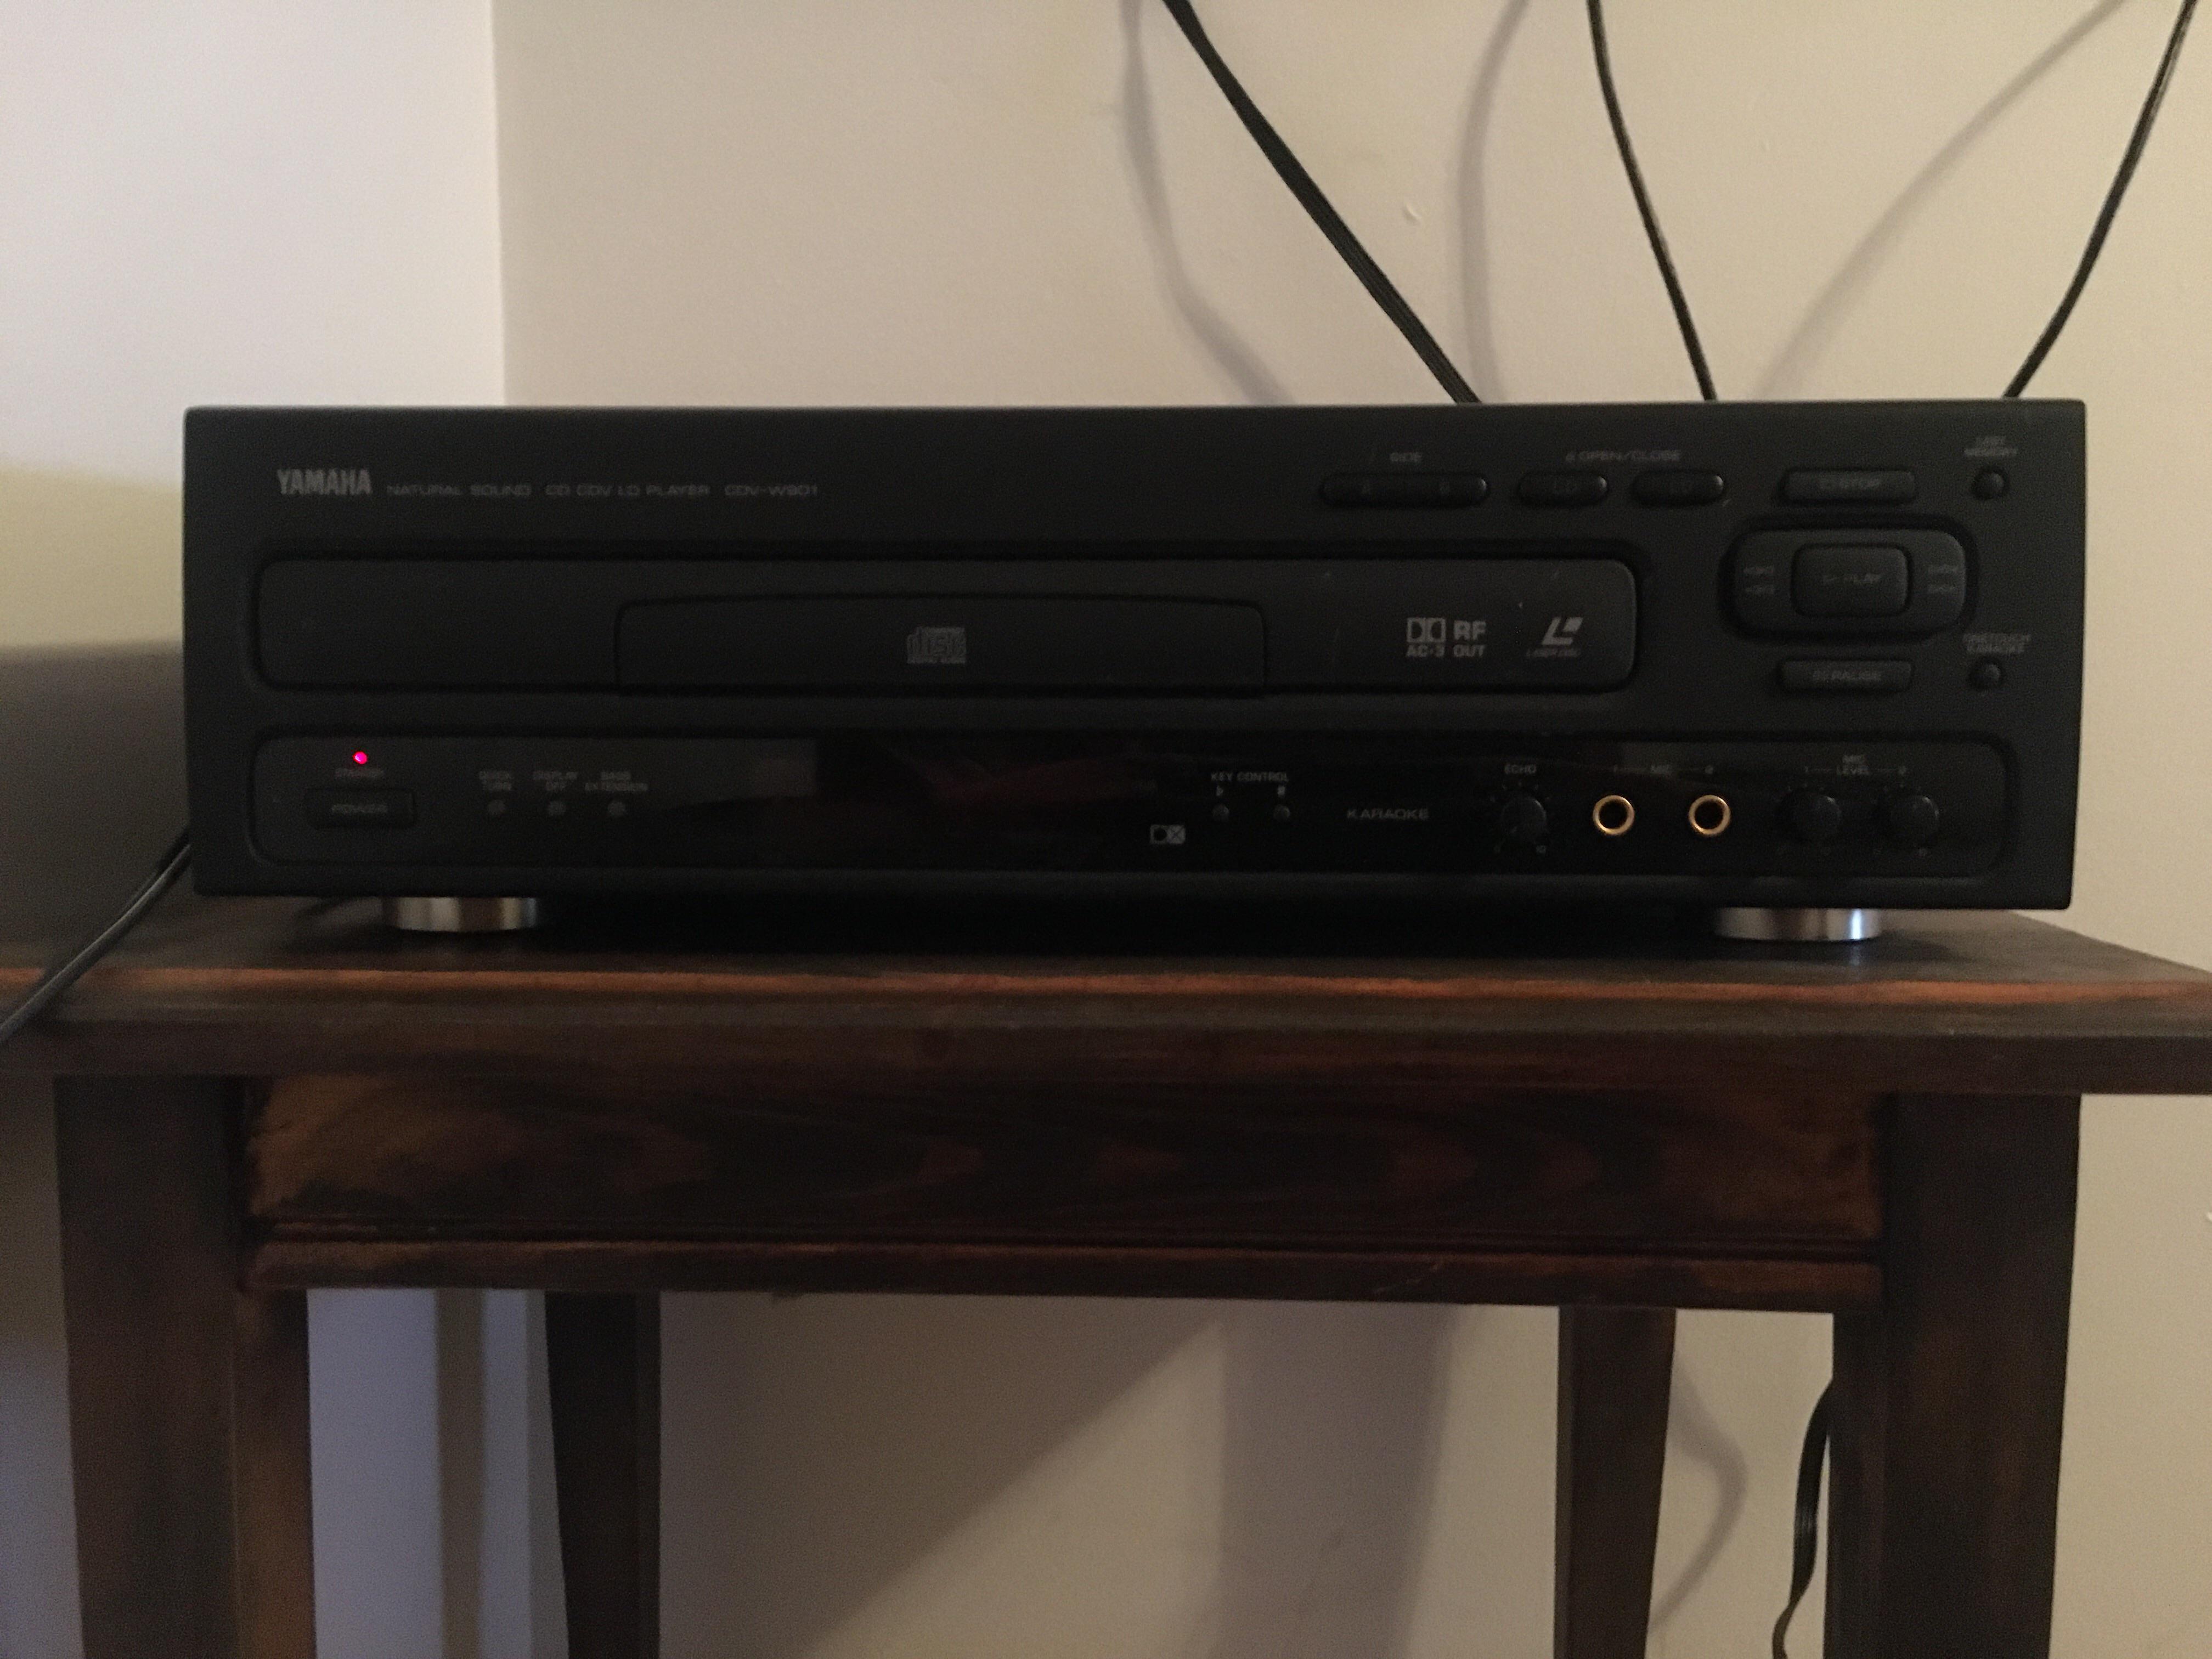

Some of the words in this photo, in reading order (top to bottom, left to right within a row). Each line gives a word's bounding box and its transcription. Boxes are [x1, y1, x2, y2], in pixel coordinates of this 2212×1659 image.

[277, 469, 372, 495] YAMAHA
[387, 484, 462, 495] NATURAL
[470, 484, 531, 496] SOUND
[546, 484, 571, 496] CD
[646, 484, 710, 496] PLAYER
[1454, 620, 1486, 641] RF
[1406, 644, 1445, 658] AC-3
[1453, 644, 1486, 658] OUT
[1504, 763, 1537, 775] ECHO
[1211, 772, 1233, 782] KEY
[1237, 772, 1289, 782] CONTROL
[1347, 809, 1429, 820] KARAOKE
